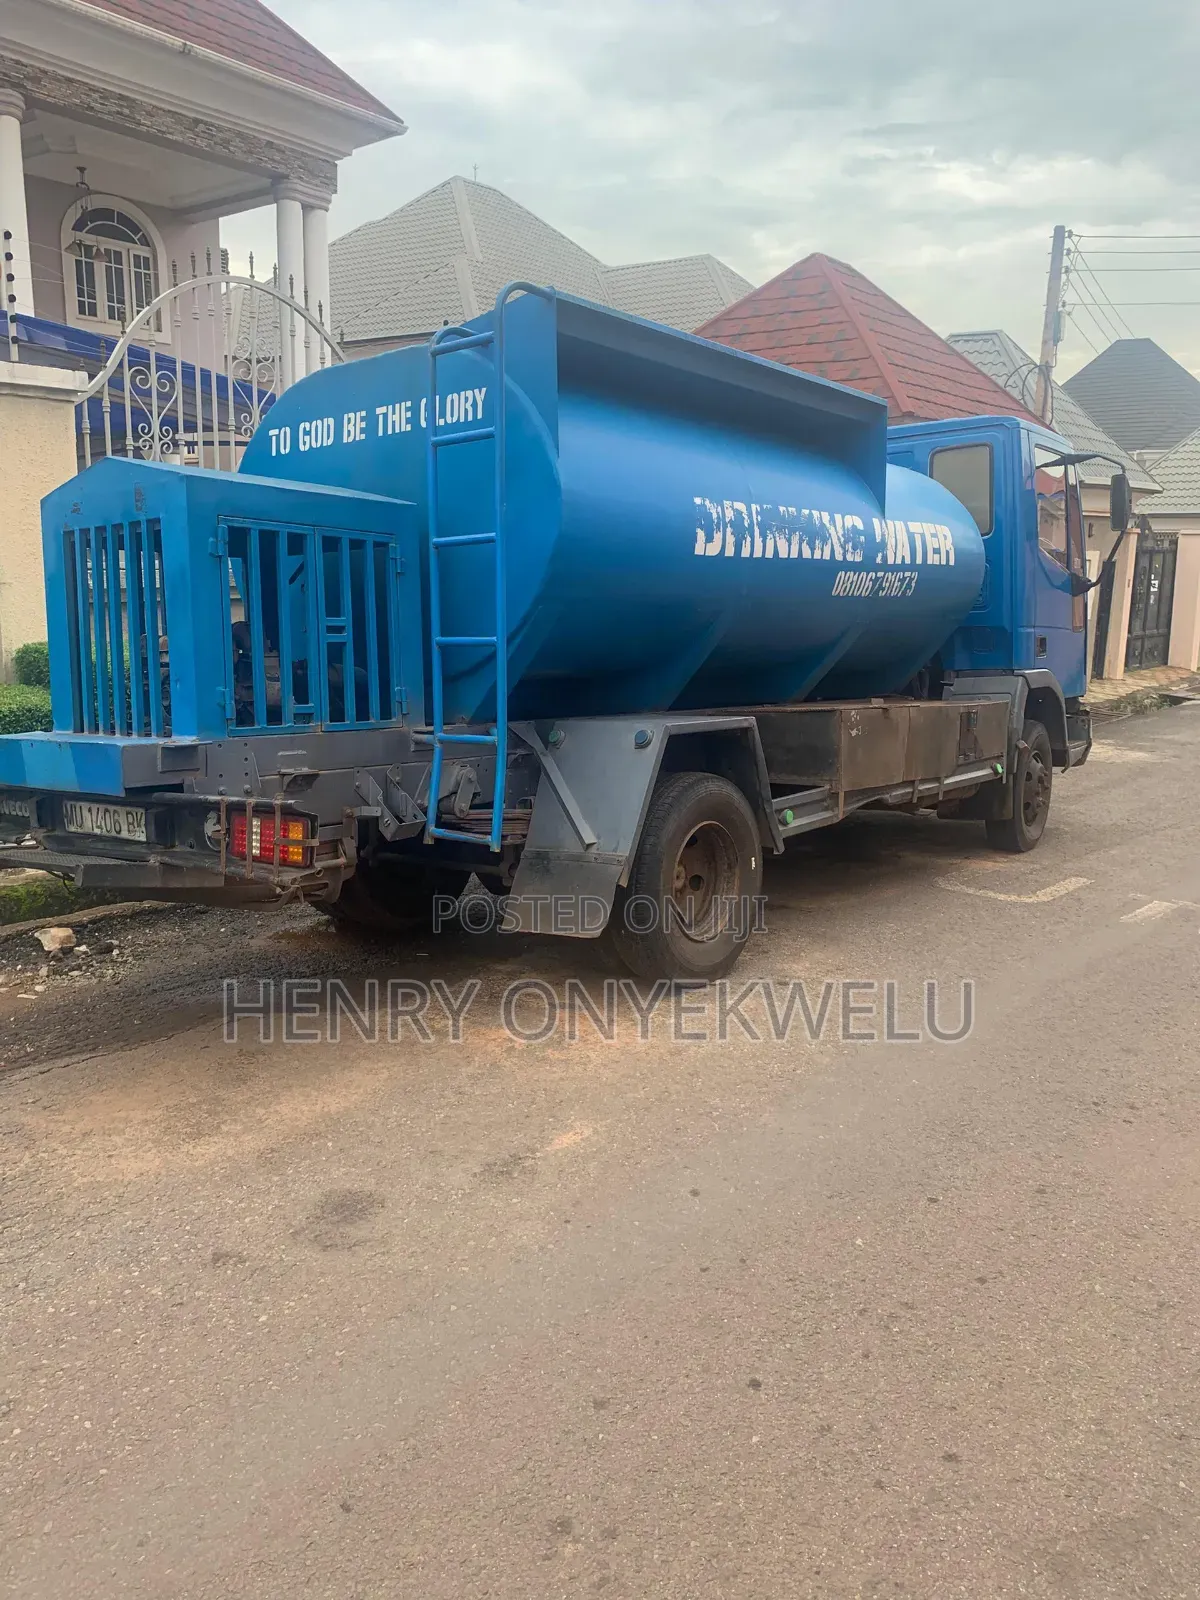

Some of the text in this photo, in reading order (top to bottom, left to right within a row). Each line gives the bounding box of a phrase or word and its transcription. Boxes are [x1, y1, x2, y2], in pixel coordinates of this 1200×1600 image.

[268, 426, 291, 457] TO
[299, 417, 335, 452] GOD
[343, 410, 367, 444] BE
[375, 400, 412, 437] THE
[872, 517, 955, 566] WATER
[831, 571, 918, 597] 08106791673
[88, 805, 122, 835] 1406
